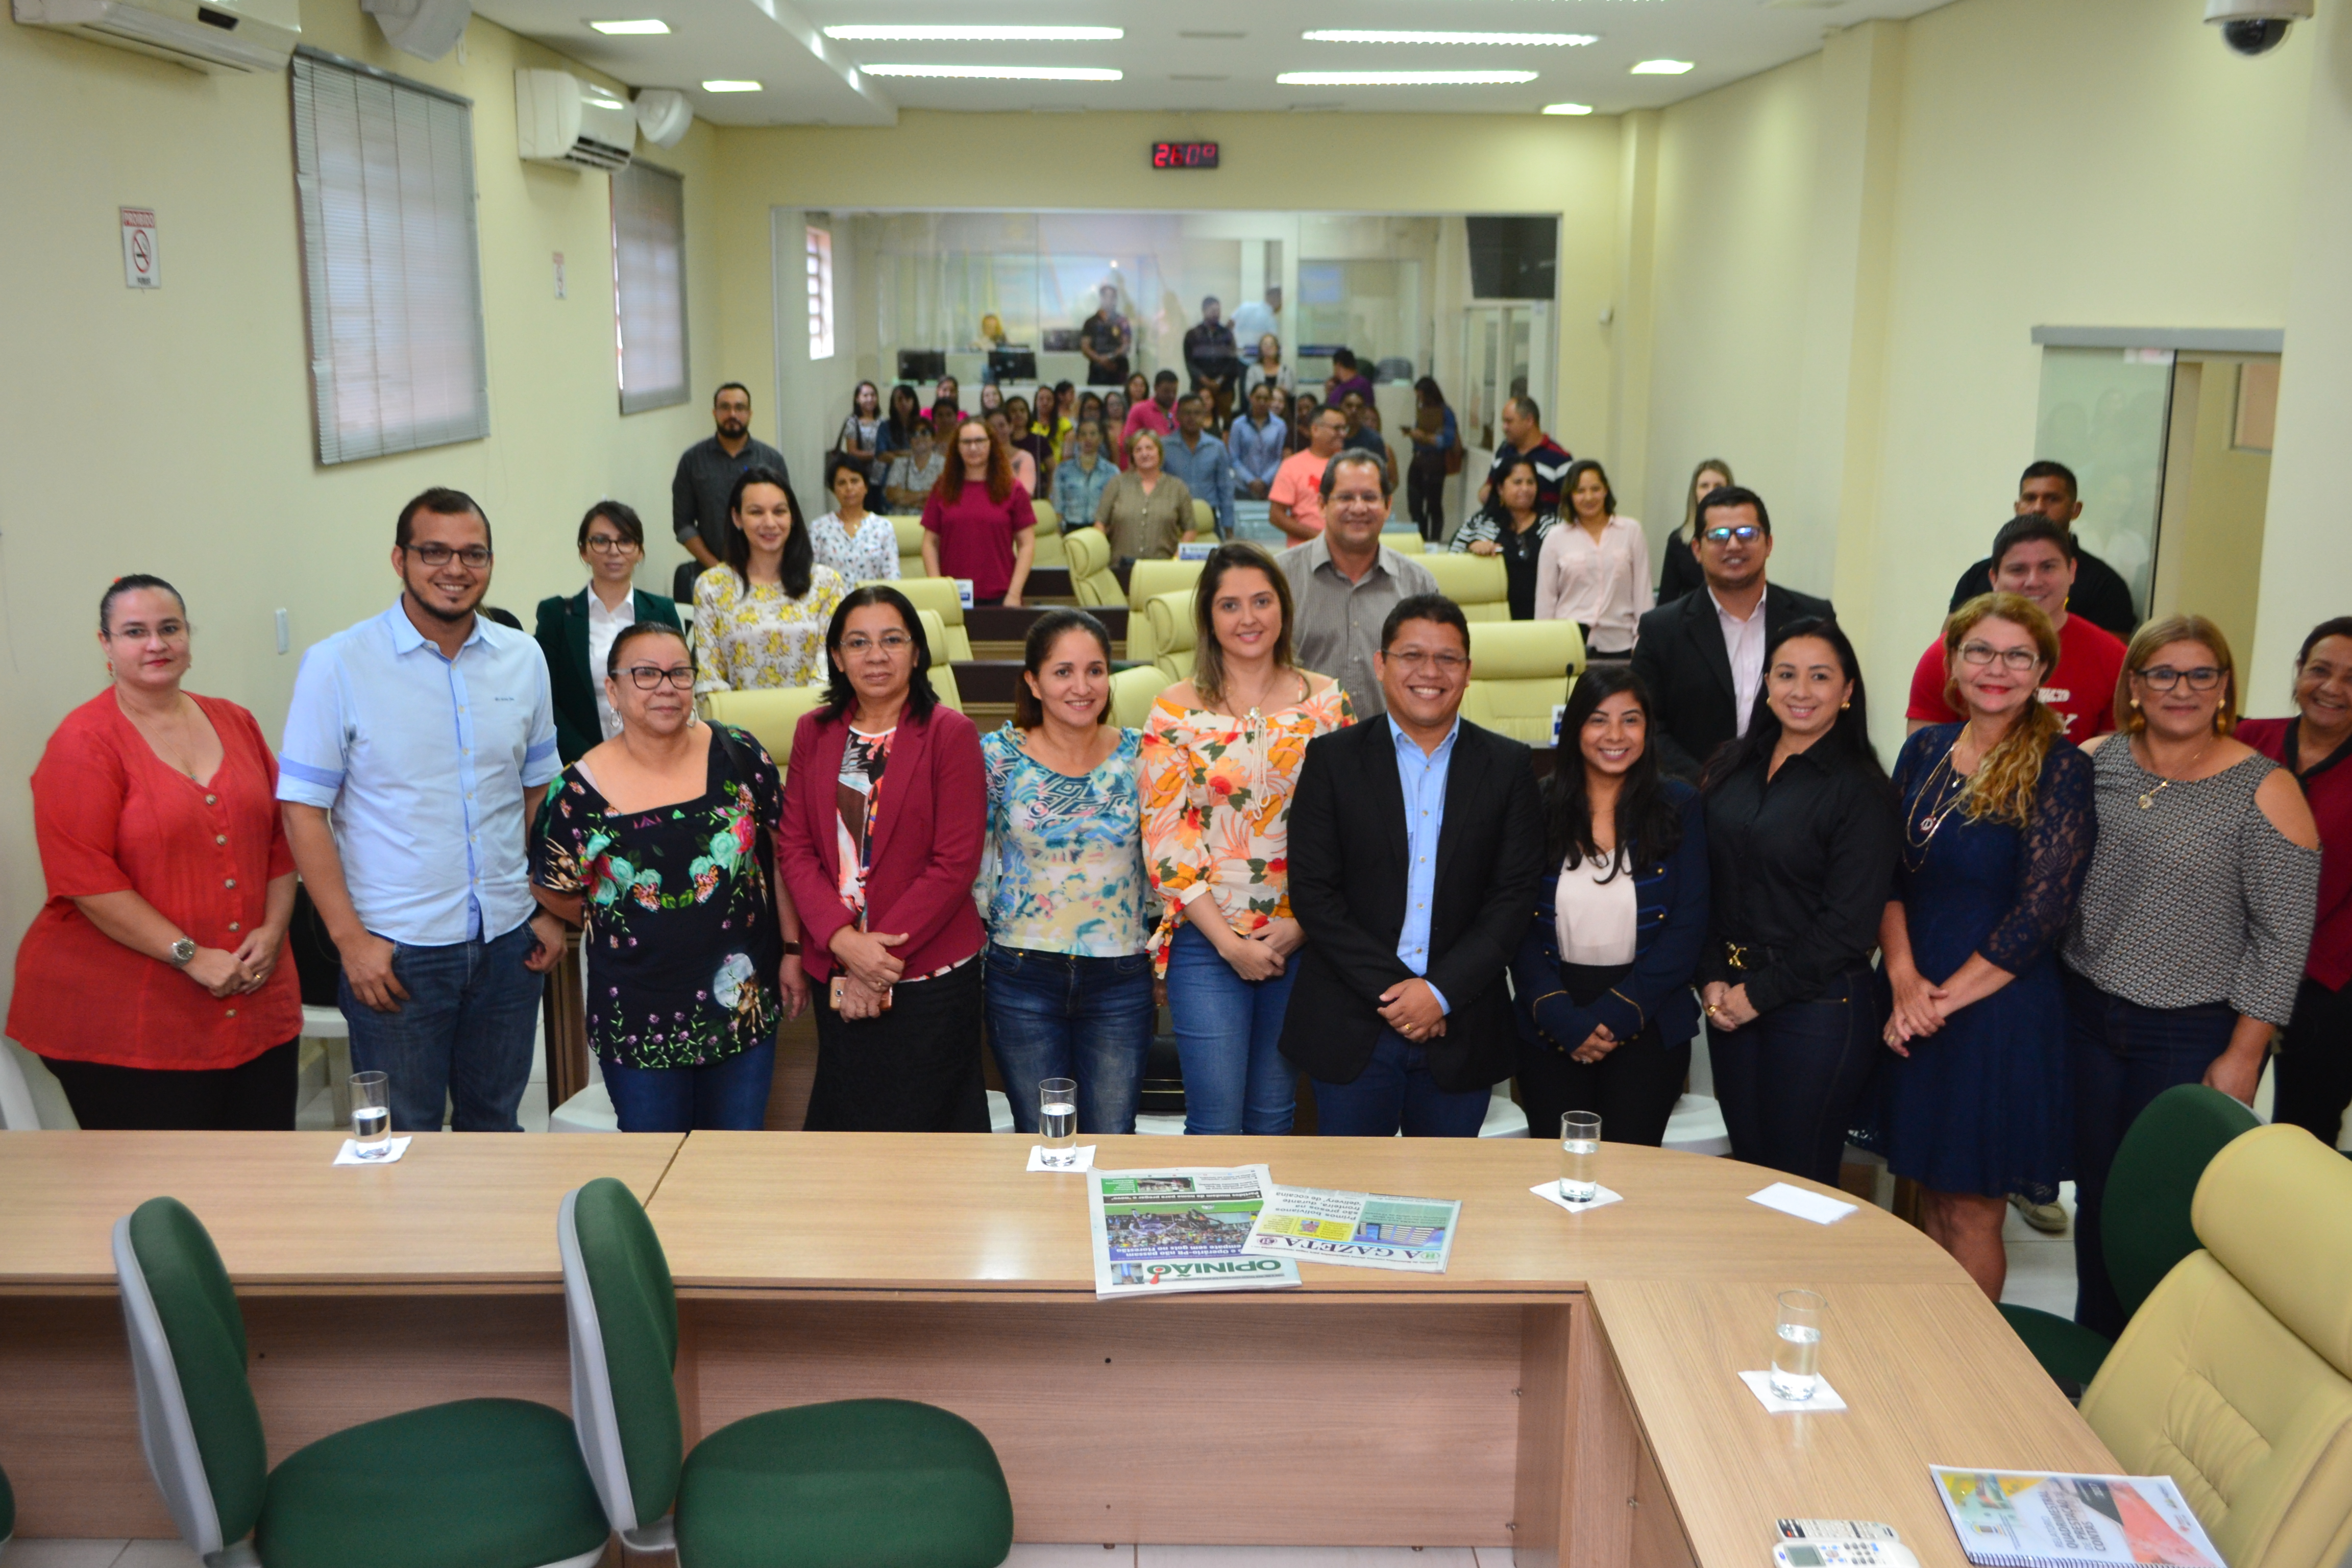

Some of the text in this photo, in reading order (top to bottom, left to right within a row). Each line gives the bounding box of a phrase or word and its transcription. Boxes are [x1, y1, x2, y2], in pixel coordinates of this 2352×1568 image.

[124, 212, 155, 228] PROIBIDO
[1275, 1208, 1321, 1216] bolivianos
[1284, 1237, 1423, 1259] A GAZETA
[2039, 1490, 2079, 1549] QUADRIMESTRAL
[2056, 1499, 2088, 1539] PRESTAÇÃO
[2081, 1520, 2106, 1551] CONTAS
